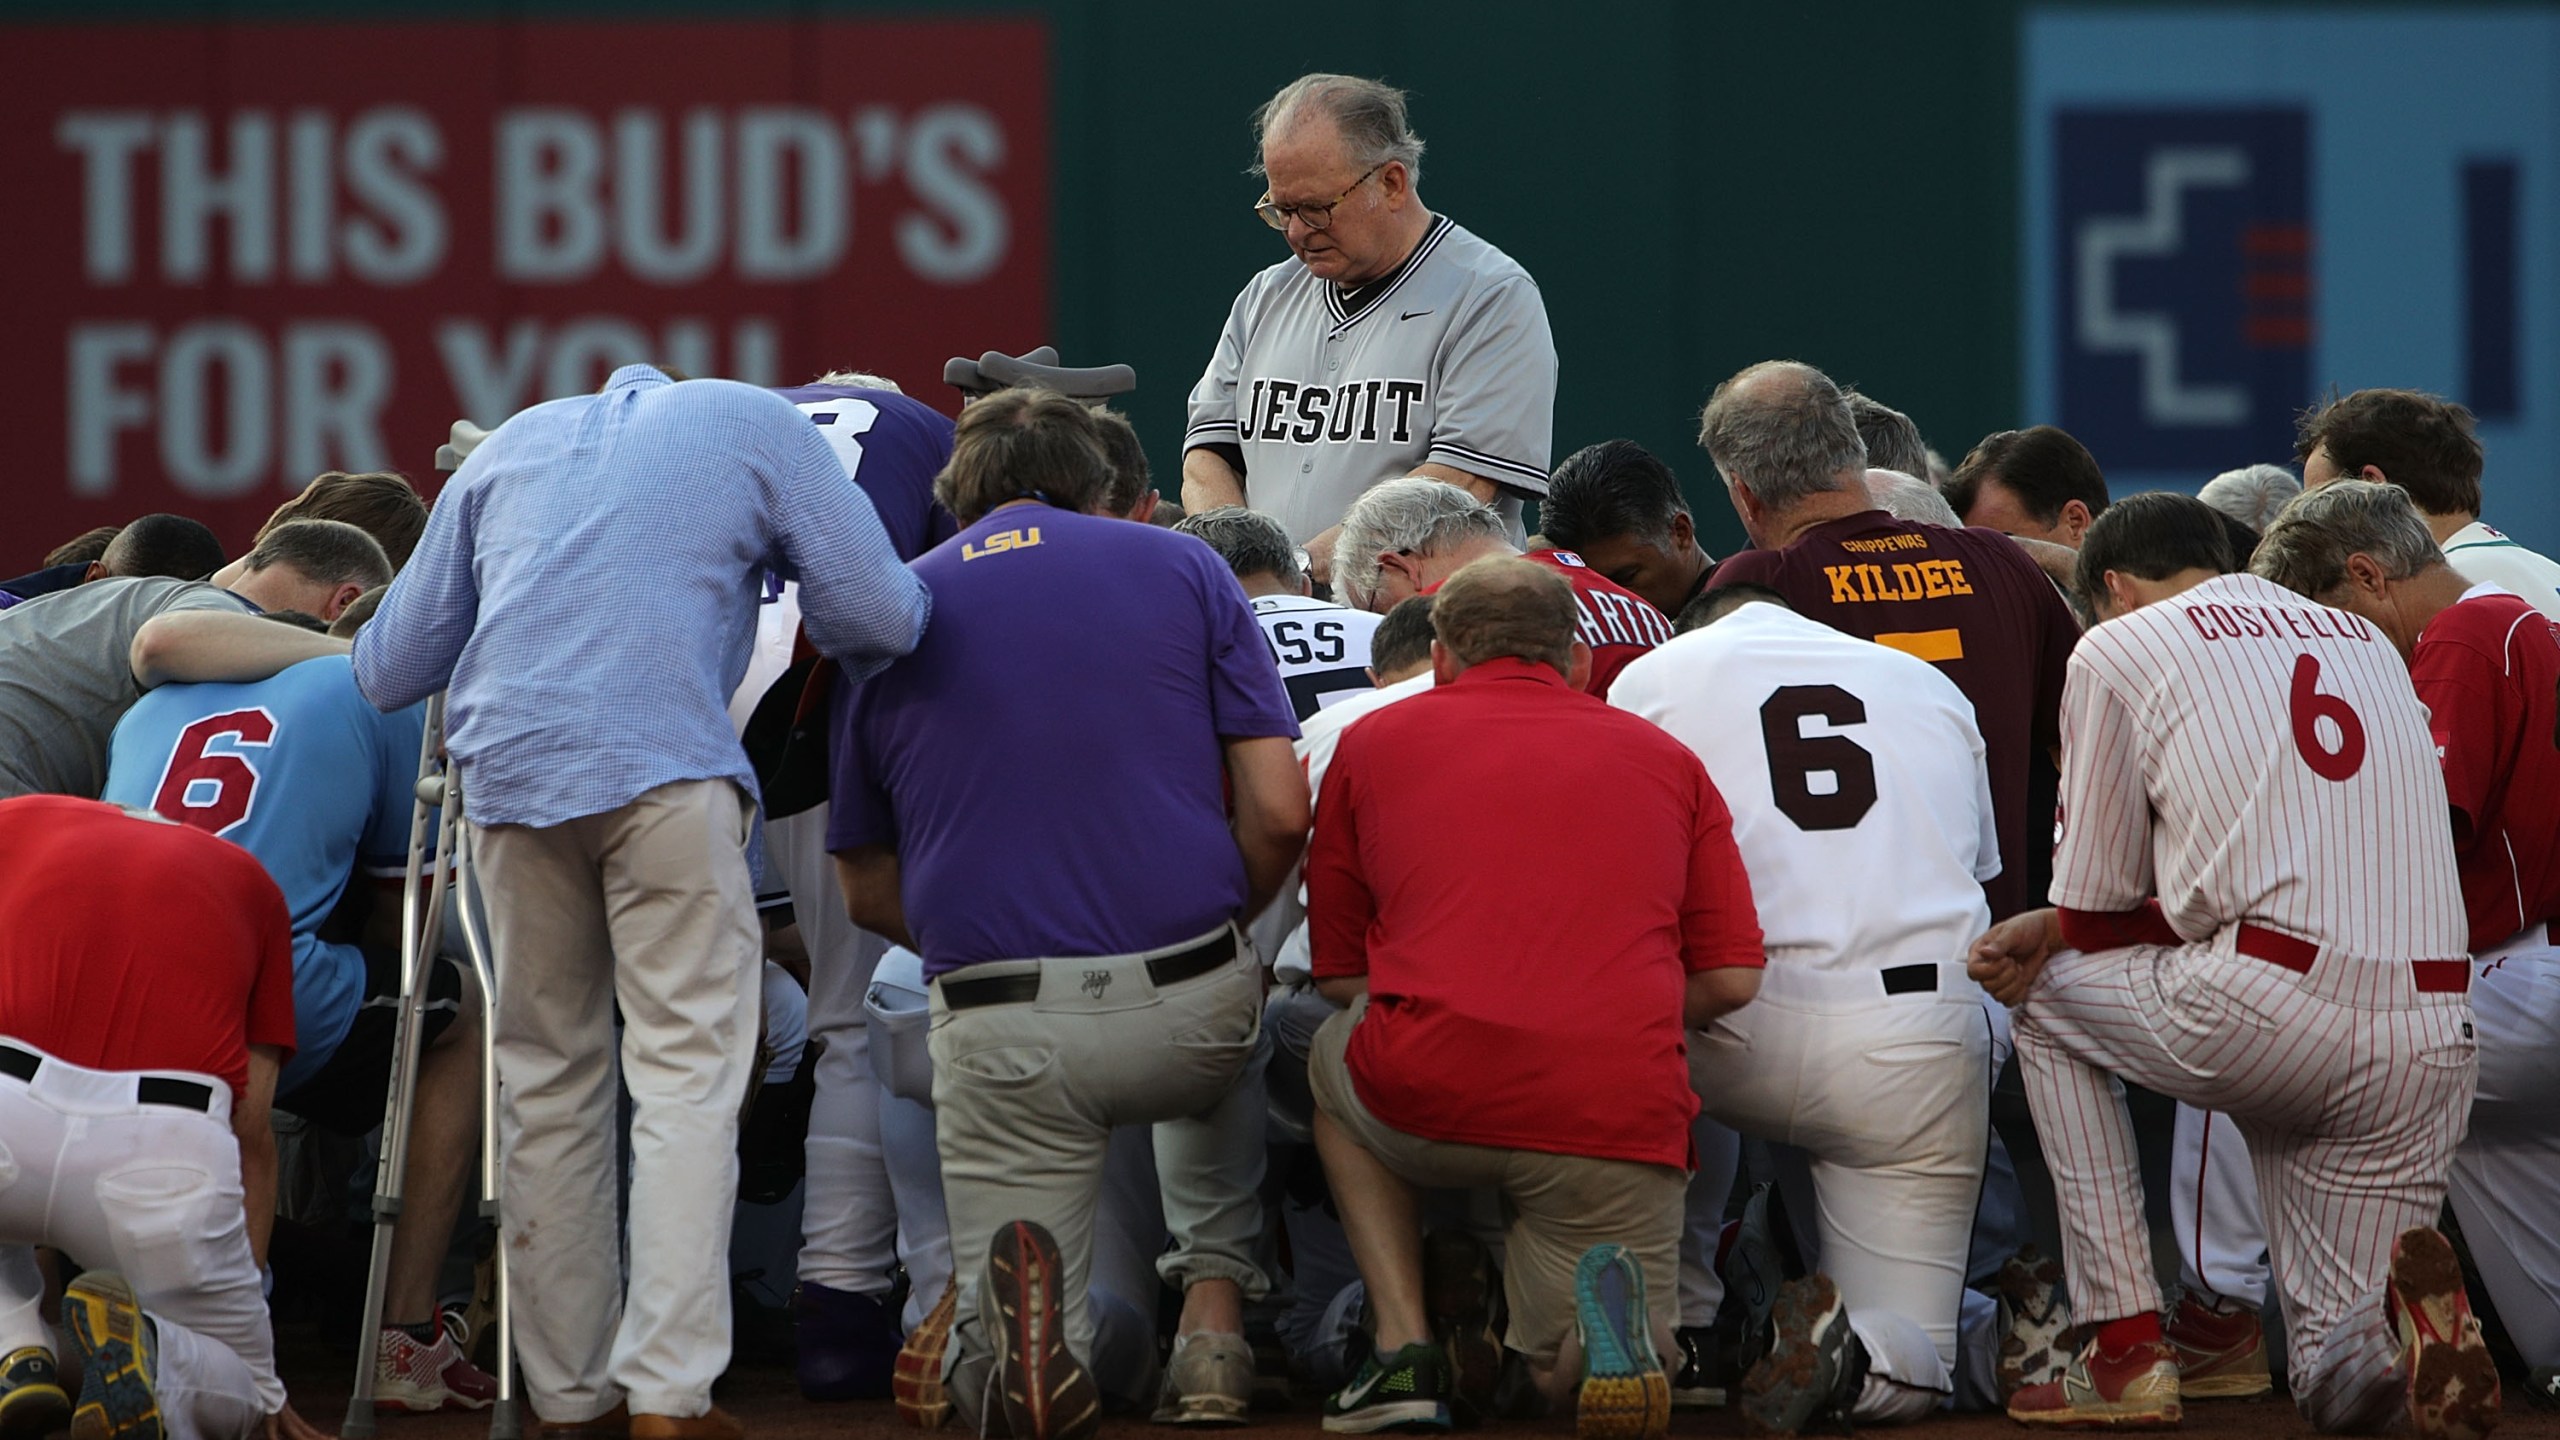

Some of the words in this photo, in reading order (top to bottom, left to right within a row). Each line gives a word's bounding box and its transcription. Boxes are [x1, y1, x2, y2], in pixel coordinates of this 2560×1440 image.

[58, 108, 448, 285] THIS
[496, 107, 1006, 284] BUD'S
[69, 321, 391, 495] FOR
[1239, 377, 1426, 445] JESUIT
[961, 527, 1040, 562] LSU
[1823, 559, 1974, 603] KILDEE
[1841, 534, 1928, 553] CHIPPEWAS
[2186, 603, 2372, 643] COSTELLO
[1760, 684, 1878, 832] 6
[2290, 653, 2366, 782] 6
[149, 706, 279, 837] 6
